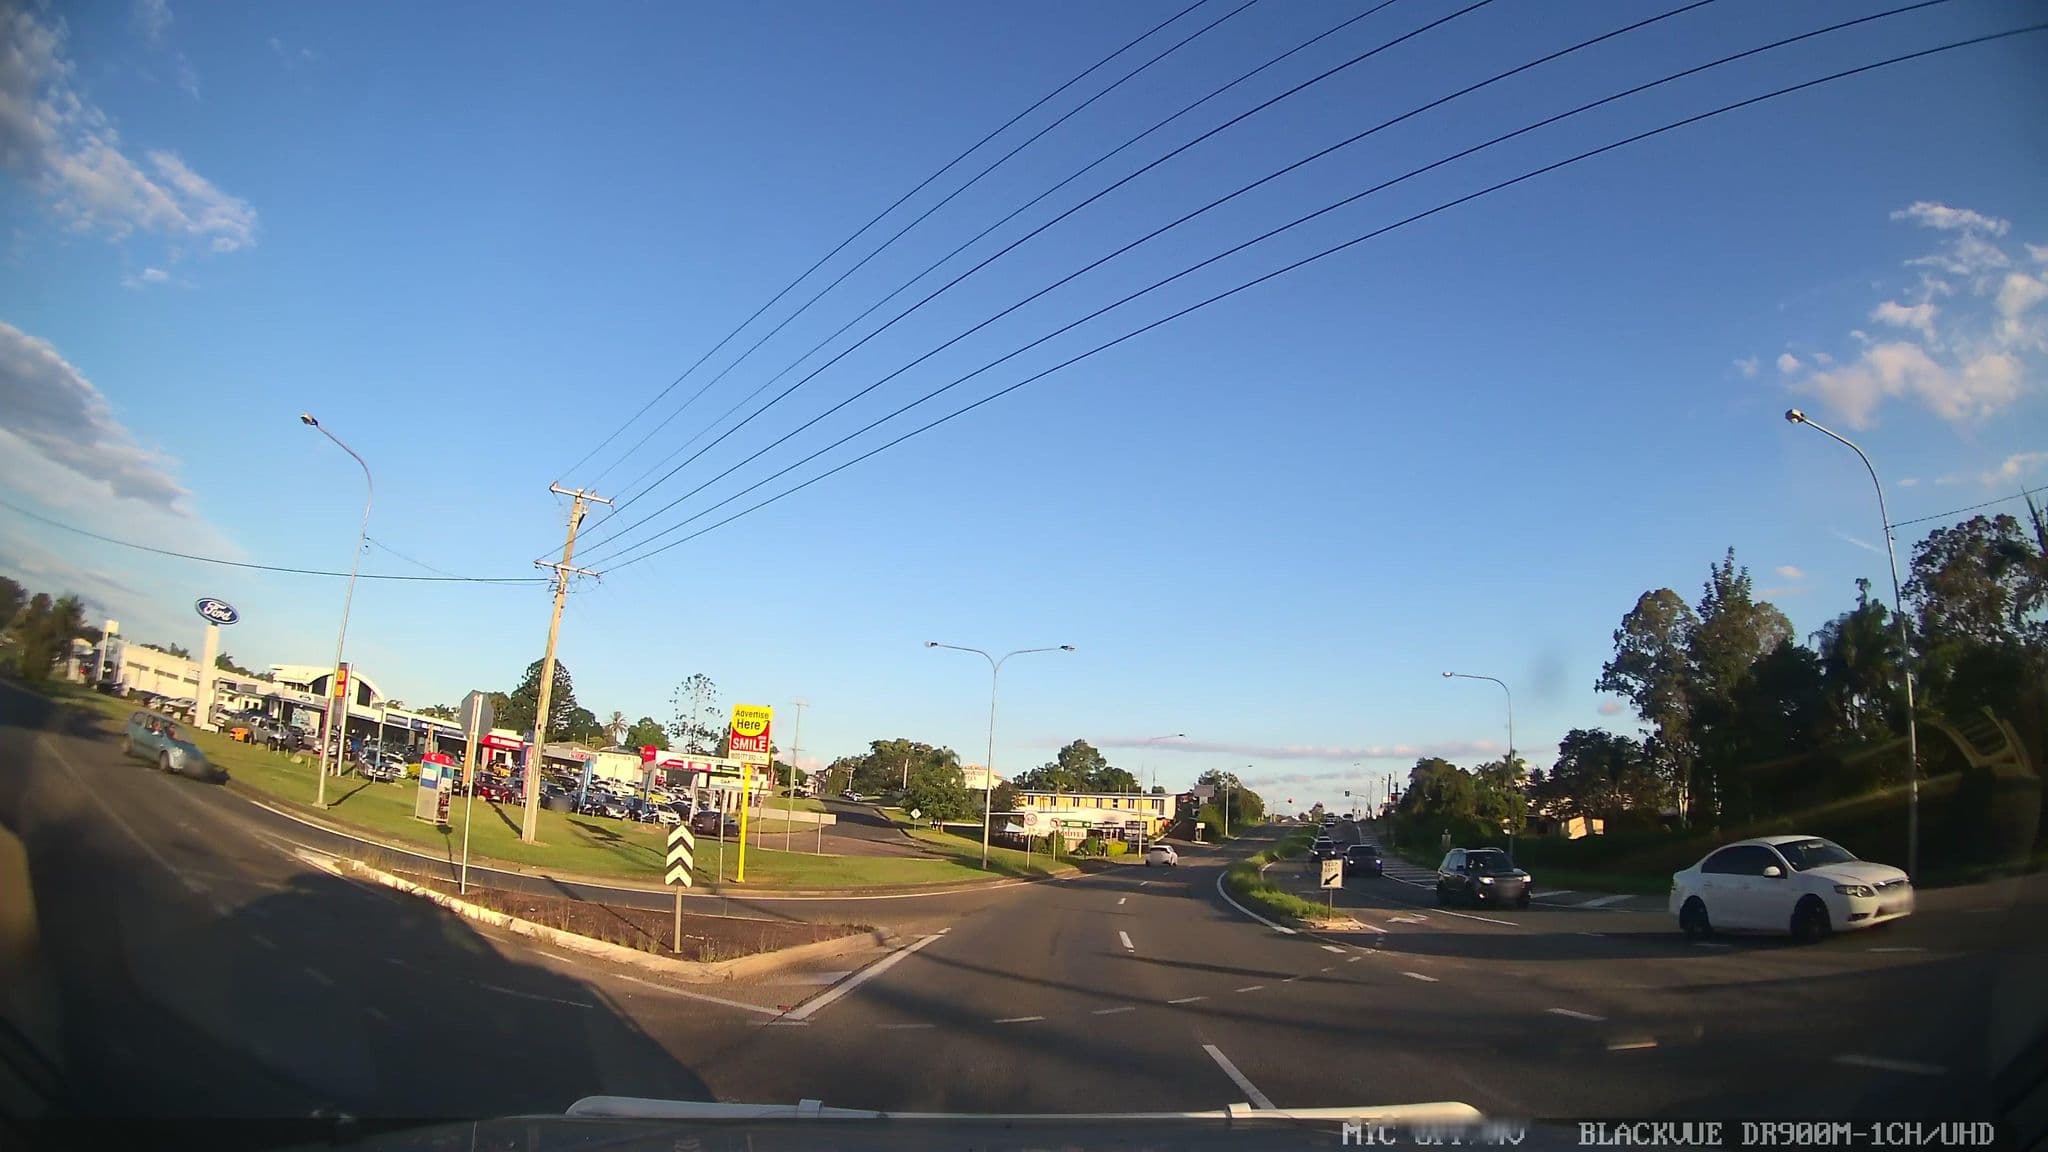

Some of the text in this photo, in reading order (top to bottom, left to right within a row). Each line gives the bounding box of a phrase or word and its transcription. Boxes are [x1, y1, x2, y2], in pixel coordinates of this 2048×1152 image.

[203, 601, 232, 621] Ford
[735, 709, 770, 720] Advertise
[736, 718, 761, 730] Here
[732, 737, 767, 752] SMILE
